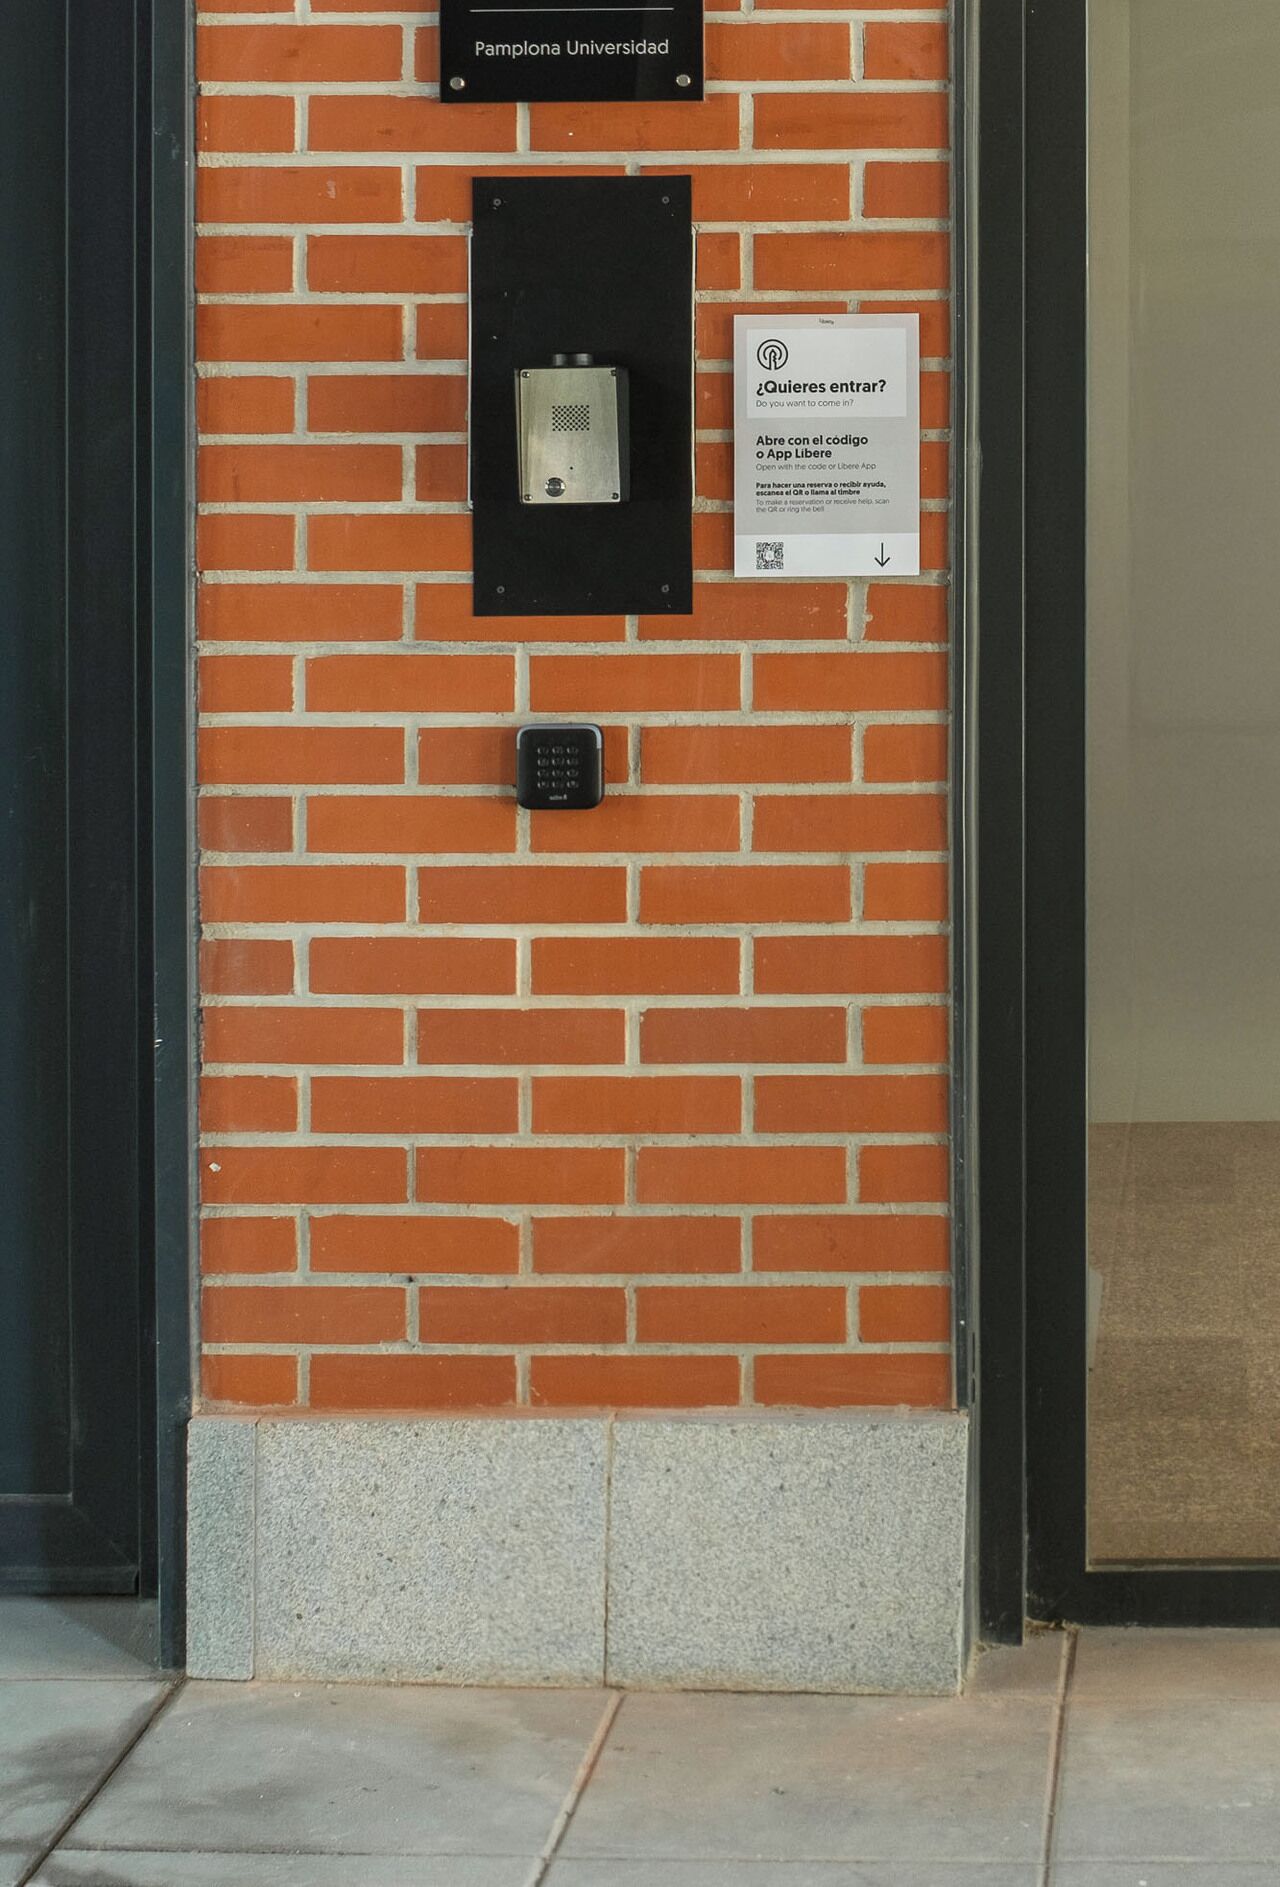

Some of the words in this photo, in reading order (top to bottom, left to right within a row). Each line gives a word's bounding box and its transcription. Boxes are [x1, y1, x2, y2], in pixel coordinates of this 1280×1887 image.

[475, 41, 561, 59] Pamplona
[567, 39, 670, 56] Universidad
[756, 380, 826, 396] ¿Quieres
[830, 379, 887, 393] entrar?
[756, 400, 767, 408] Do
[769, 400, 785, 409] you
[786, 400, 806, 408] want
[842, 399, 854, 407] in?
[756, 435, 785, 446] Abre
[787, 437, 810, 446] con
[812, 435, 823, 445] el
[825, 434, 868, 447] código
[756, 451, 764, 459] o
[766, 449, 793, 461] App
[756, 463, 776, 471] Open
